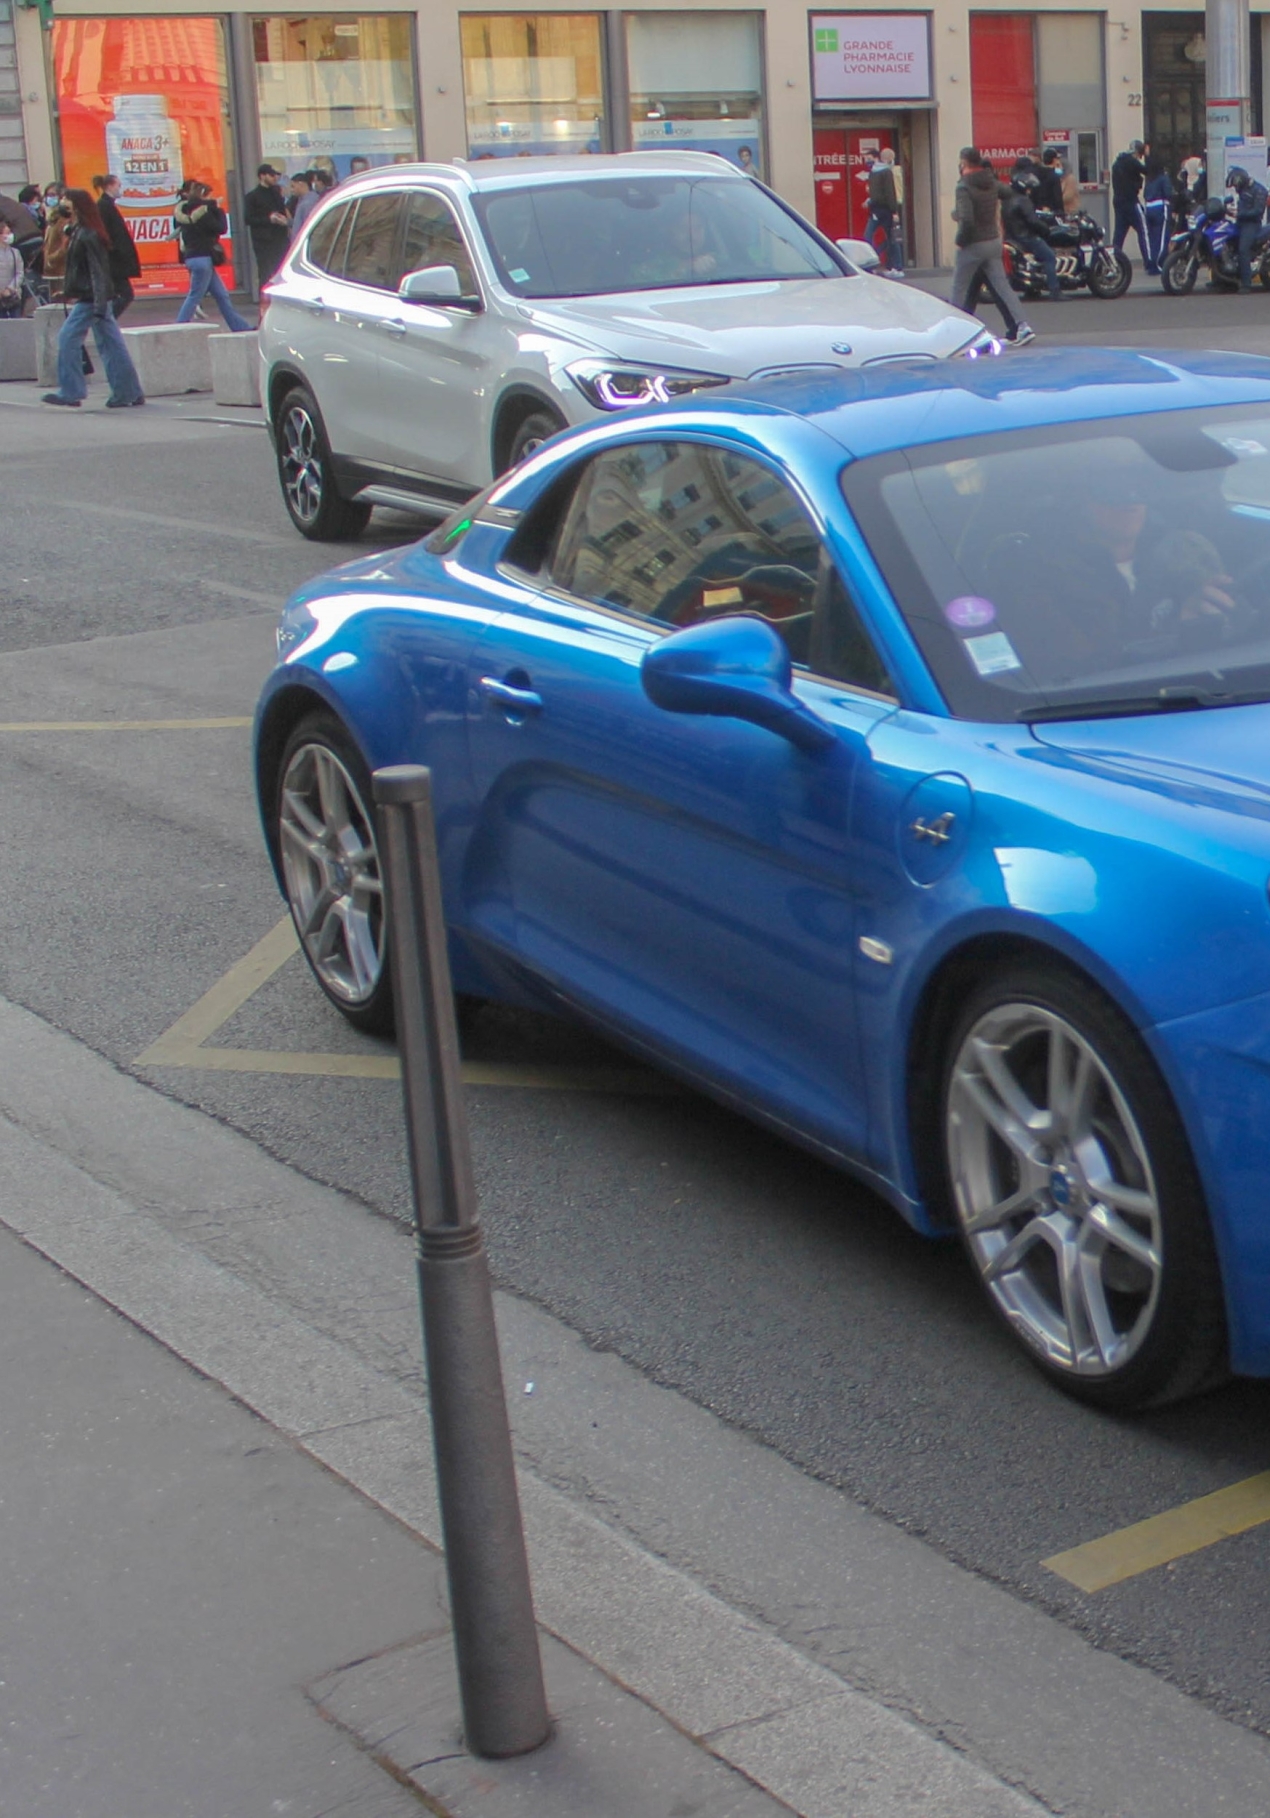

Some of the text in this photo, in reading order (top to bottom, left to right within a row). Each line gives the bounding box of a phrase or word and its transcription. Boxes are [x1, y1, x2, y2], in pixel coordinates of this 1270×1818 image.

[843, 40, 894, 51] GRANDE
[843, 52, 915, 62] PHARMACIE
[843, 63, 912, 74] LYONNAISE
[1127, 94, 1143, 107] 22
[121, 137, 153, 151] ANACA
[848, 154, 868, 166] ENT
[124, 217, 171, 241] NACA
